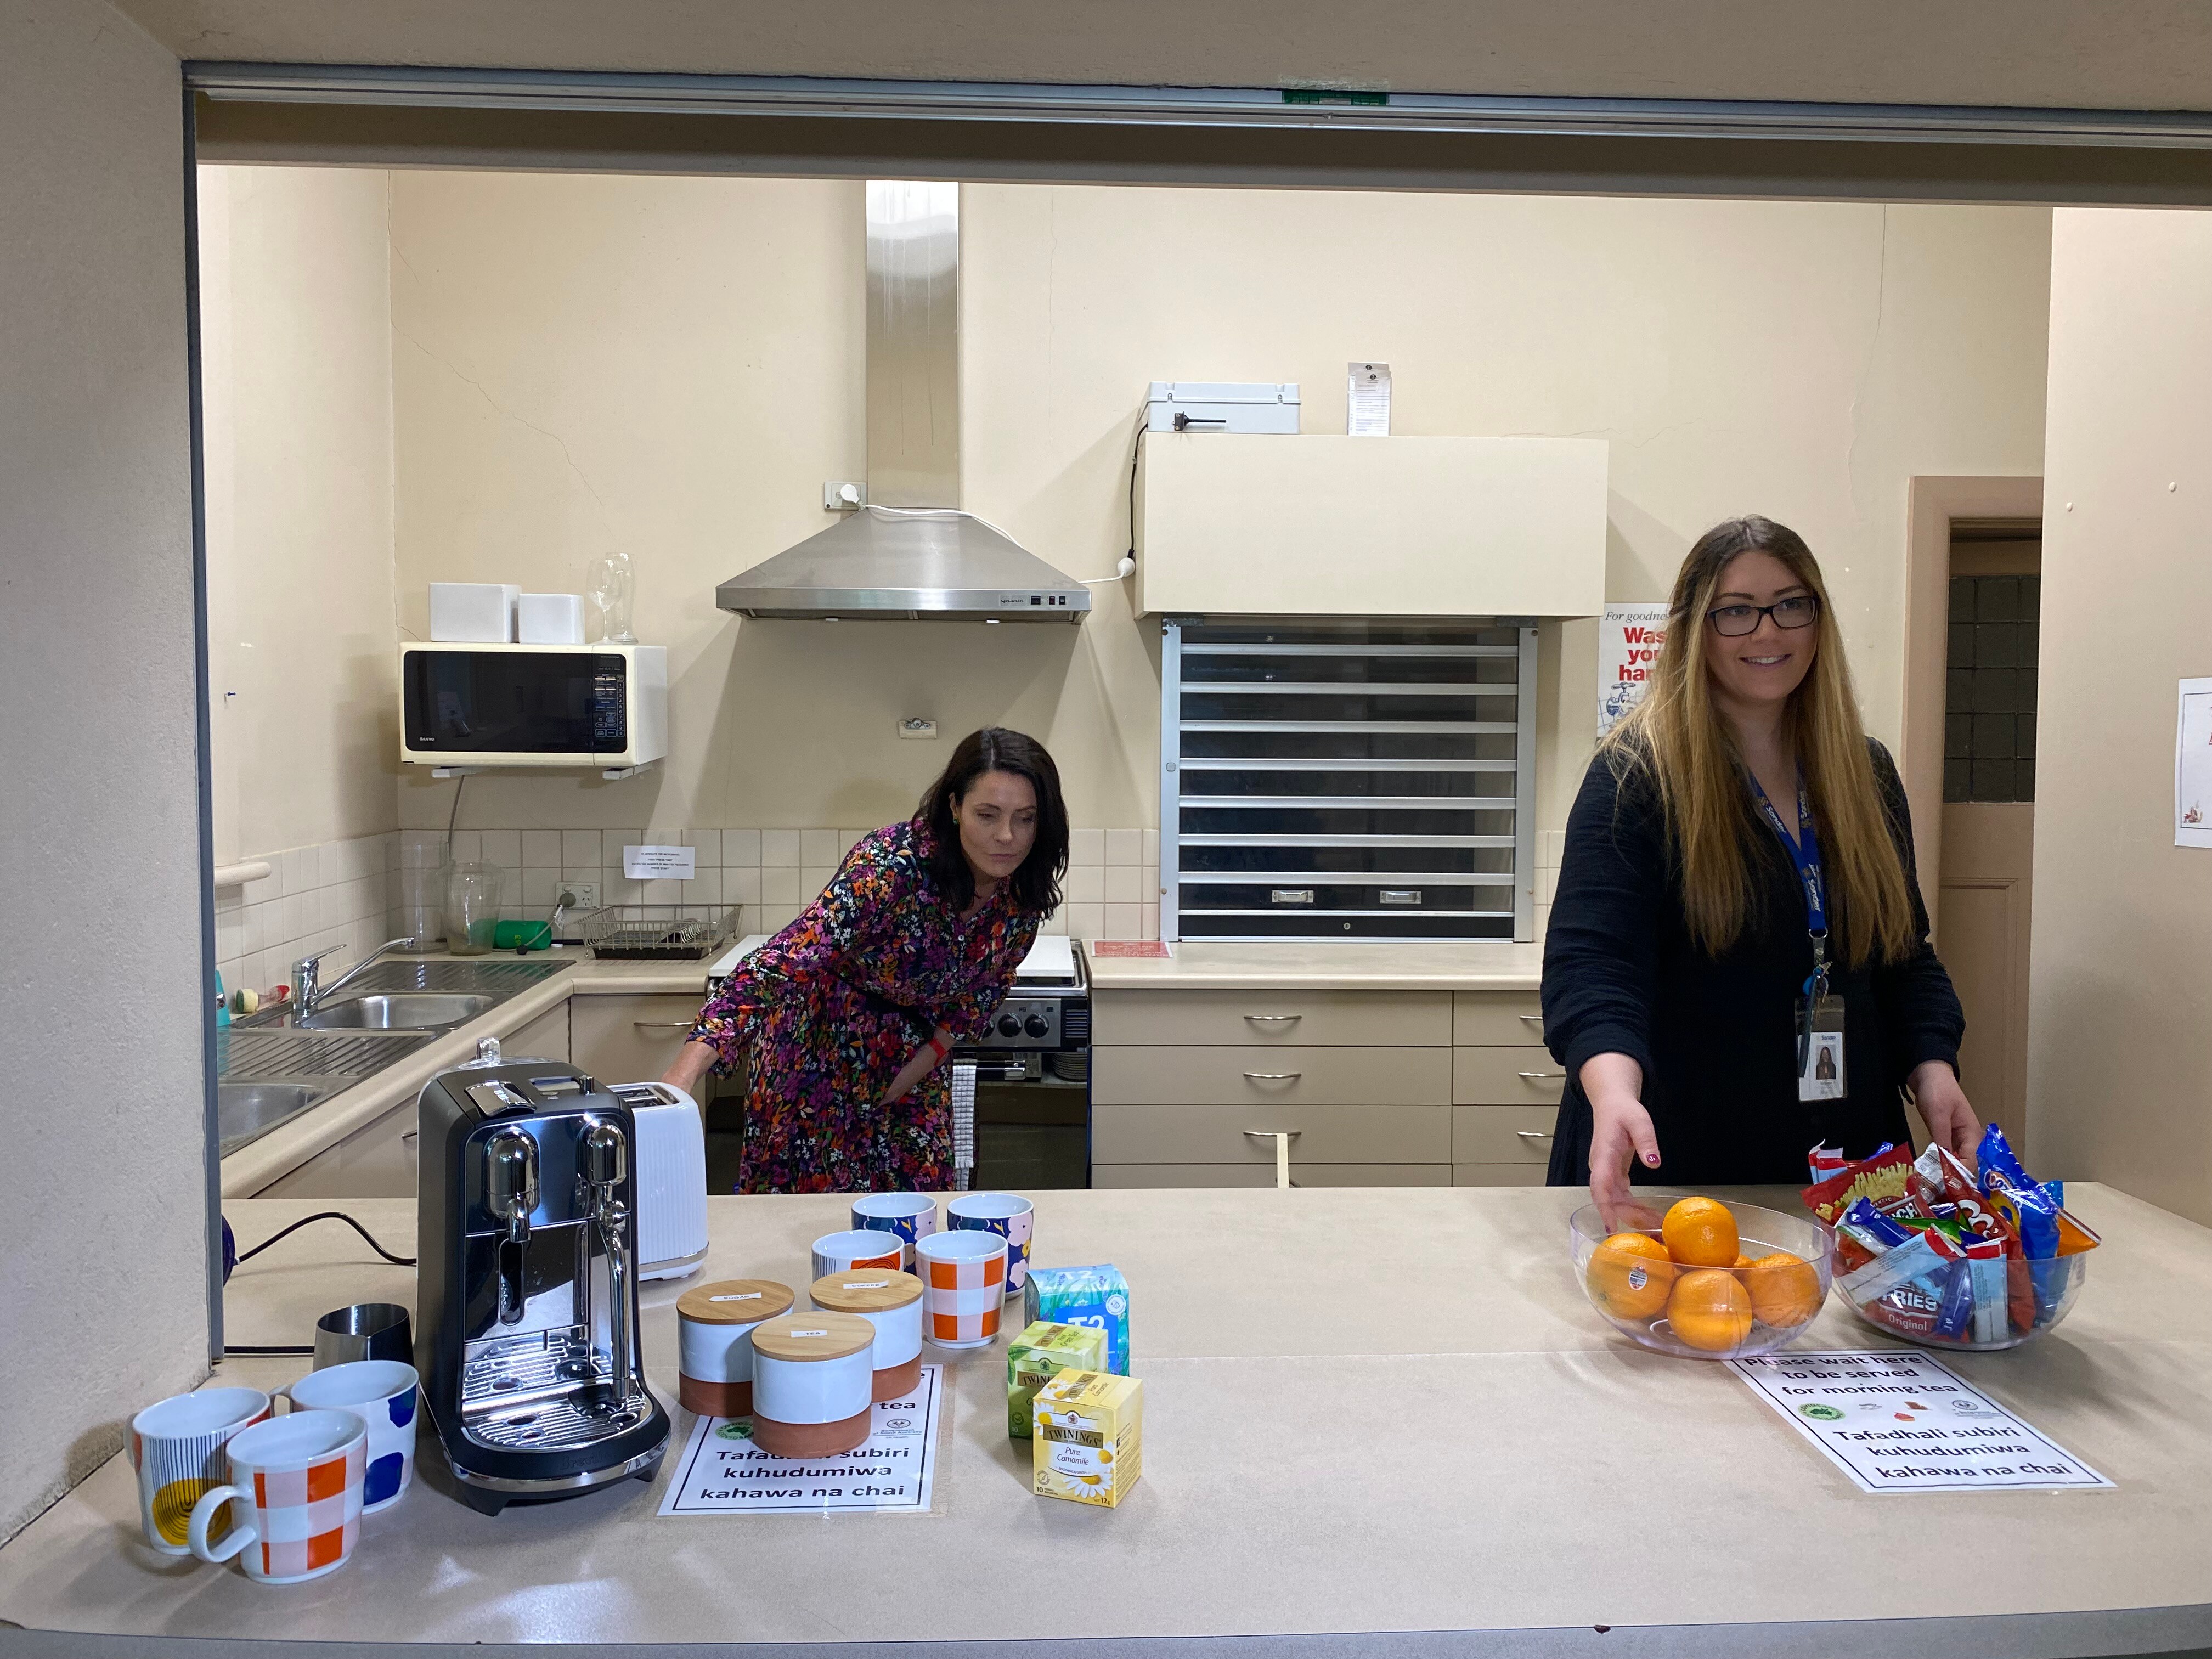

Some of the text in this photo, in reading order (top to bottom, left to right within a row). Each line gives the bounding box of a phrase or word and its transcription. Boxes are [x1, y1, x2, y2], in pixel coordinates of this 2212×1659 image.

[1605, 611, 1666, 623] For goodne
[1623, 627, 1668, 644] Was
[1888, 1314, 1927, 1331] Original
[1745, 1356, 1923, 1366] Please wait here
[1782, 1368, 1920, 1379] to be served
[1782, 1384, 1959, 1395] for morning tea
[1047, 1429, 1098, 1447] TWININGS
[1832, 1427, 2021, 1441] Tafadhali subiri
[839, 1448, 910, 1458] subiri
[1065, 1447, 1081, 1456] Pure
[1866, 1444, 2031, 1457] kuhudumiwa
[1057, 1454, 1090, 1465] Camomile
[724, 1466, 892, 1479] kuhudumiwa
[1874, 1463, 2073, 1479] kahawa na chai
[700, 1485, 905, 1499] kahawa na chai
